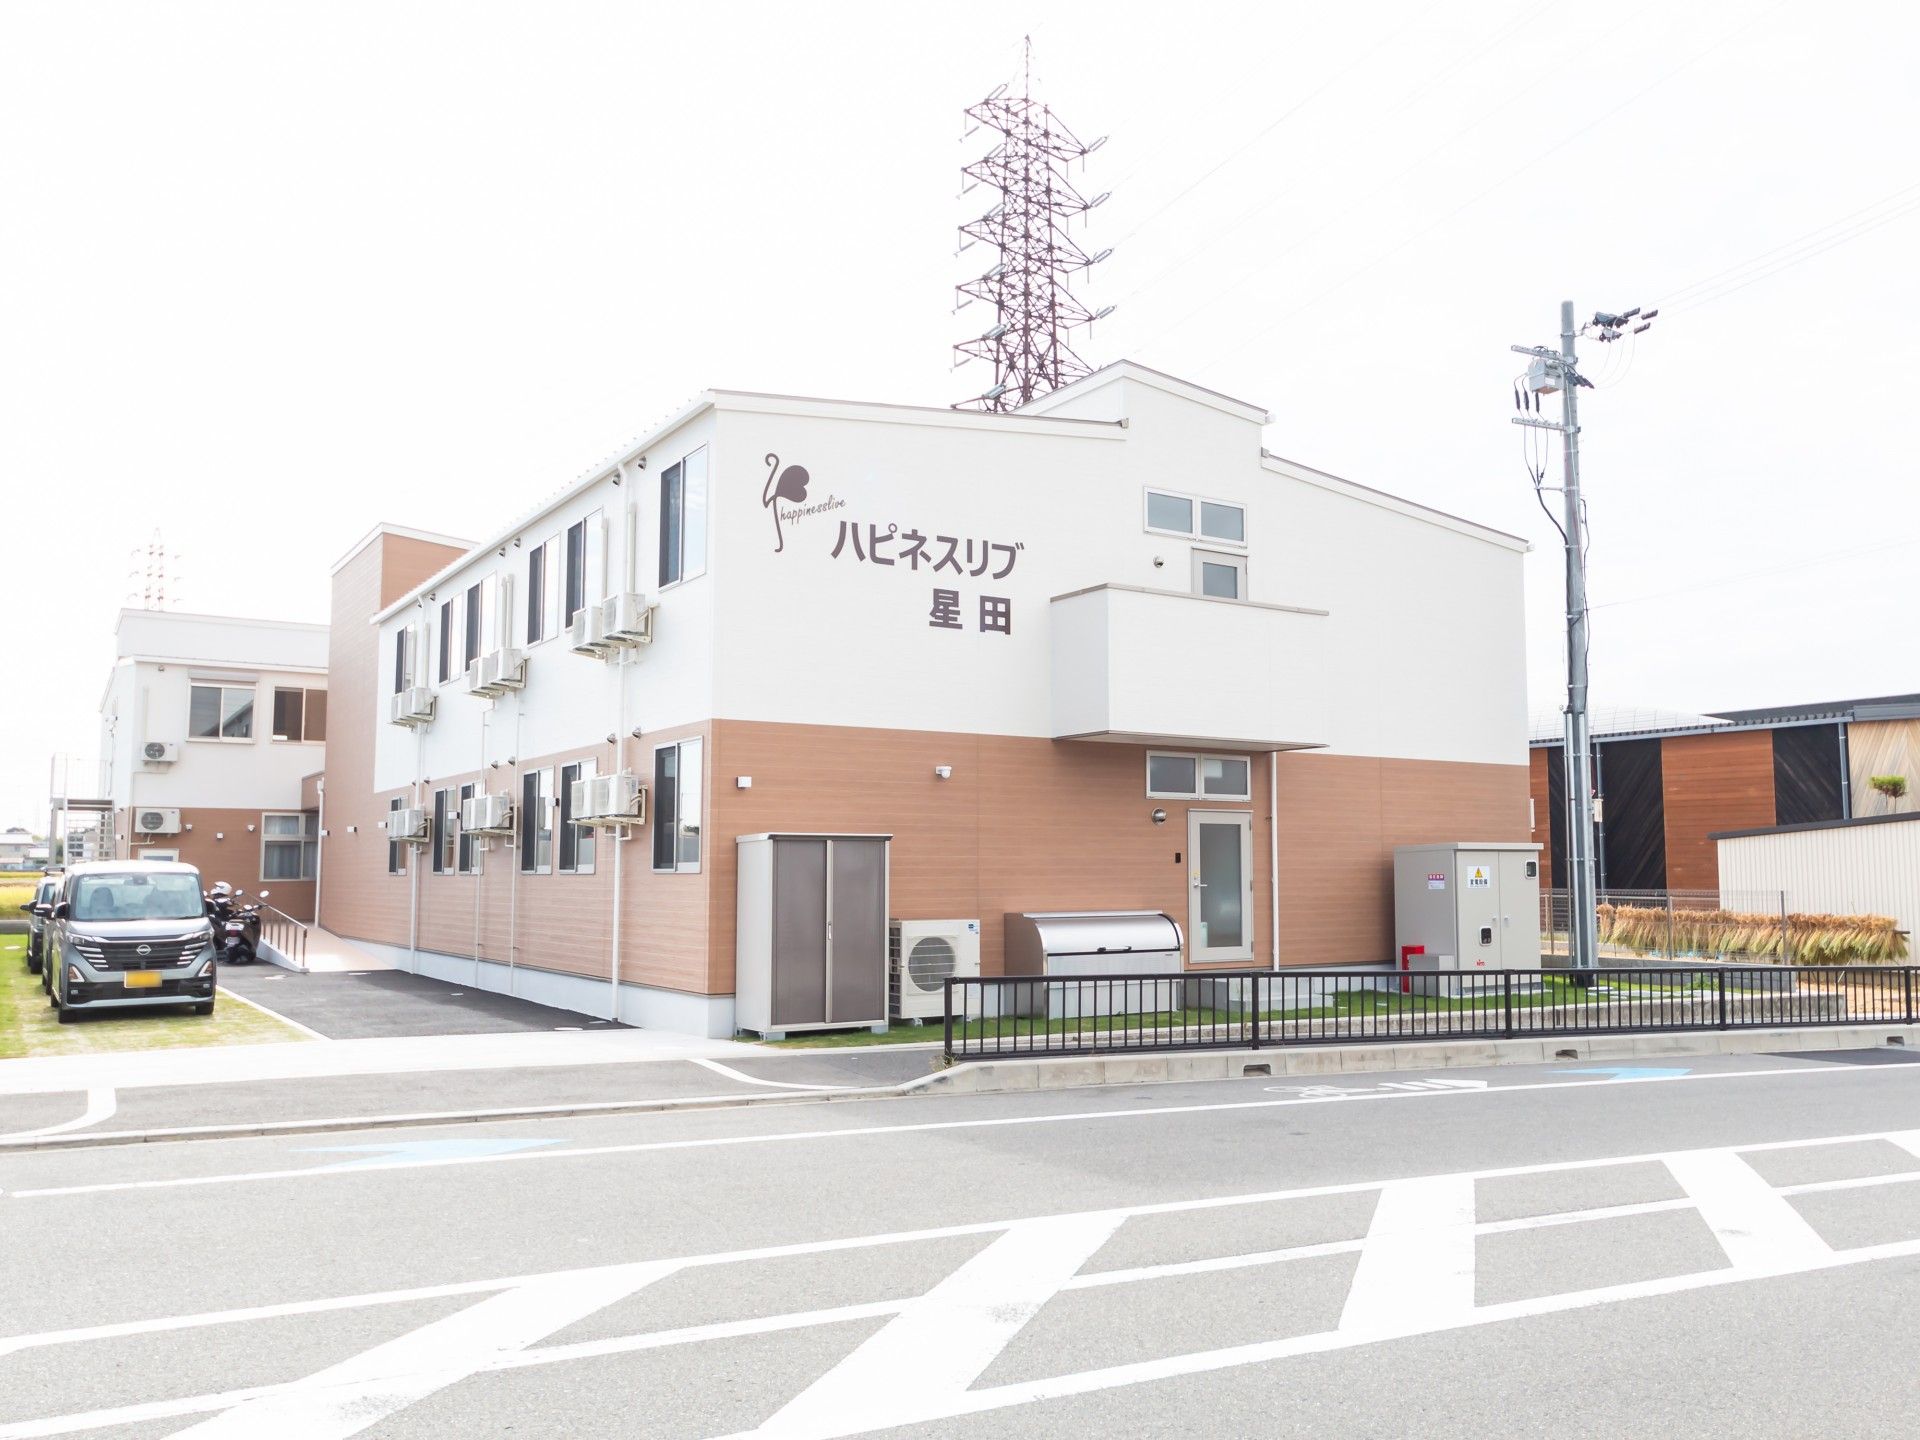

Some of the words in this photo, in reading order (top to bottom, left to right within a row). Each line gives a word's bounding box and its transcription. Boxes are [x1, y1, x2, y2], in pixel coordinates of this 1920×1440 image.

[780, 494, 846, 526] happinesslive
[831, 521, 1025, 580] ハピネスリブ
[929, 588, 1011, 635] 星田
